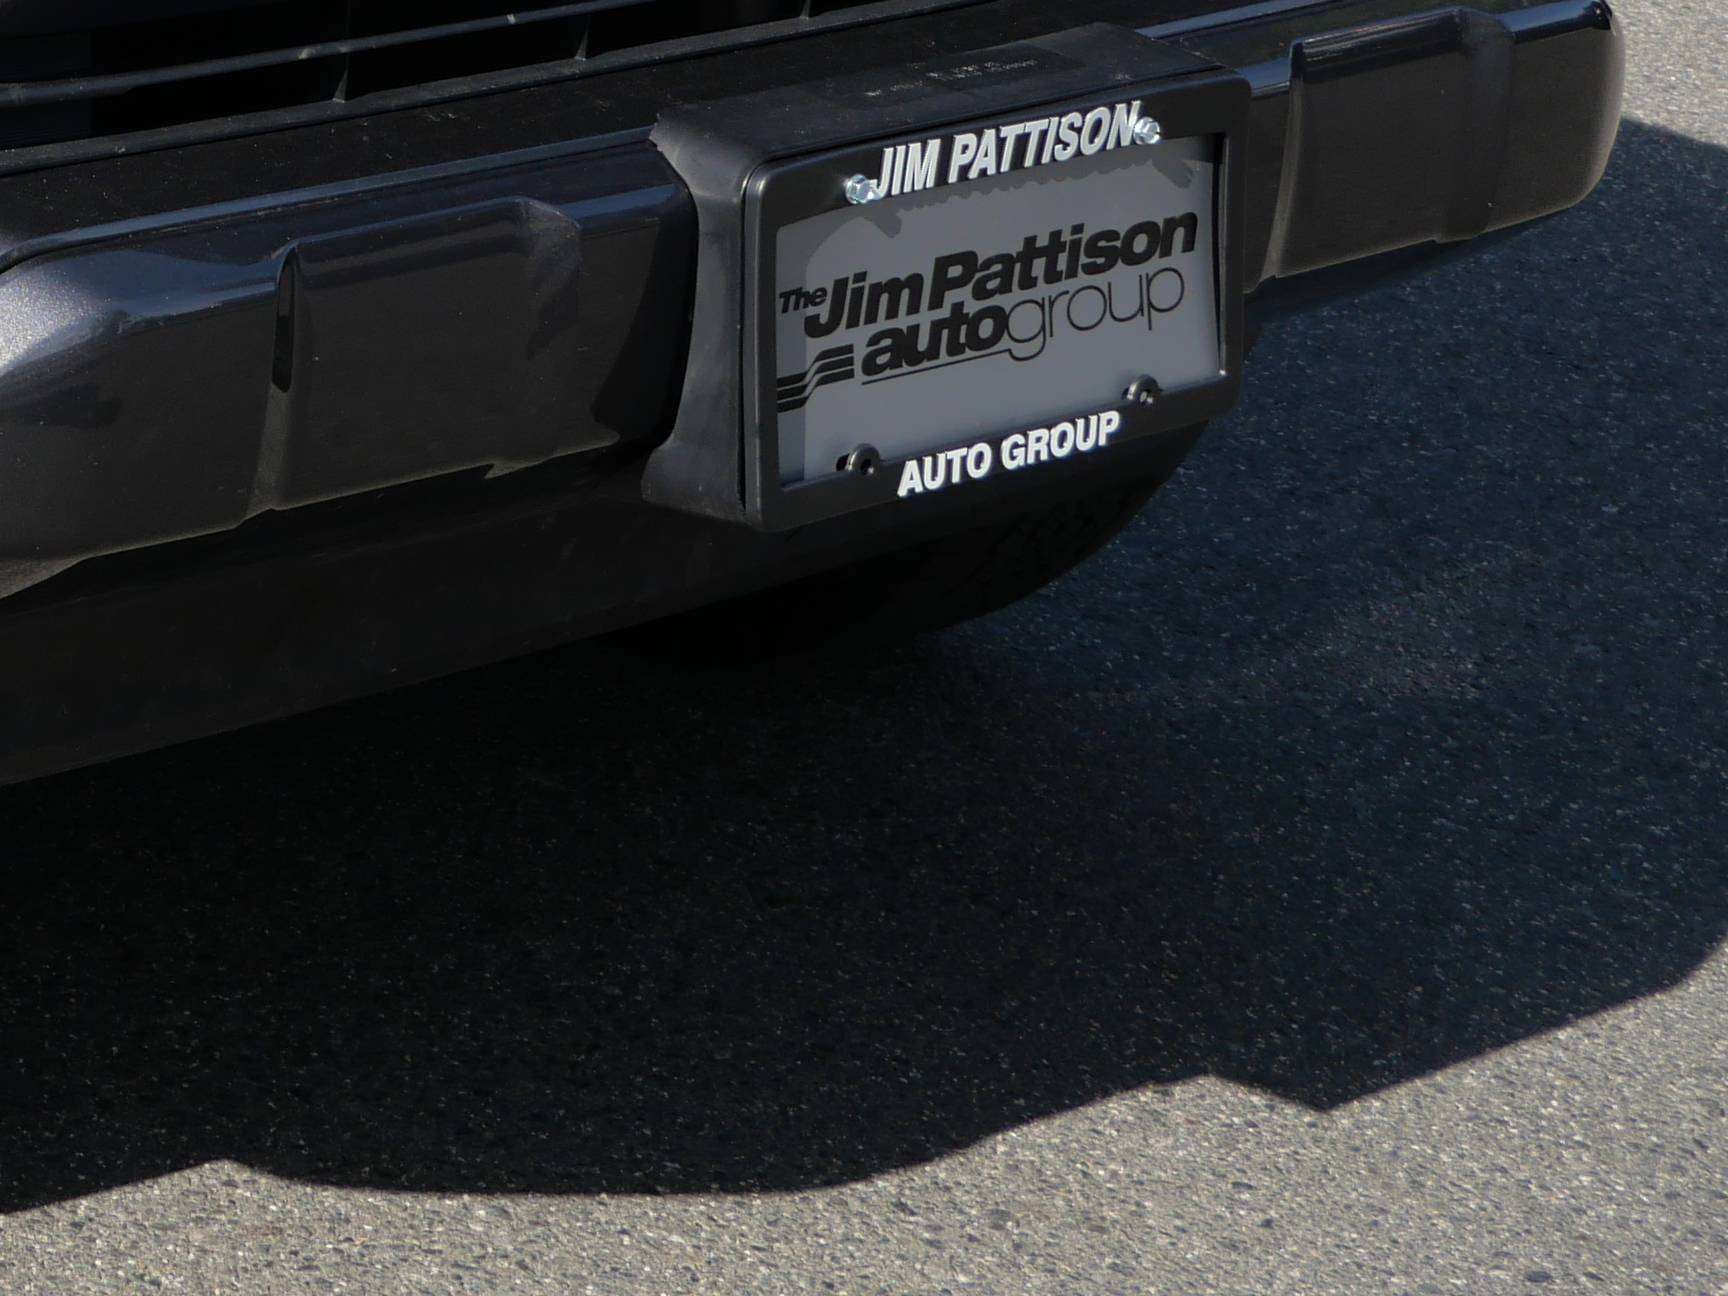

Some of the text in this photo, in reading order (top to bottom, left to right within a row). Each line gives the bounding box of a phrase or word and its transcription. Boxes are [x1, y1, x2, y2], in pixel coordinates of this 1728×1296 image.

[872, 100, 1143, 198] JIM PATTISON
[779, 212, 1198, 339] The Jim Pattison
[897, 410, 1120, 497] AUTO GROUP
